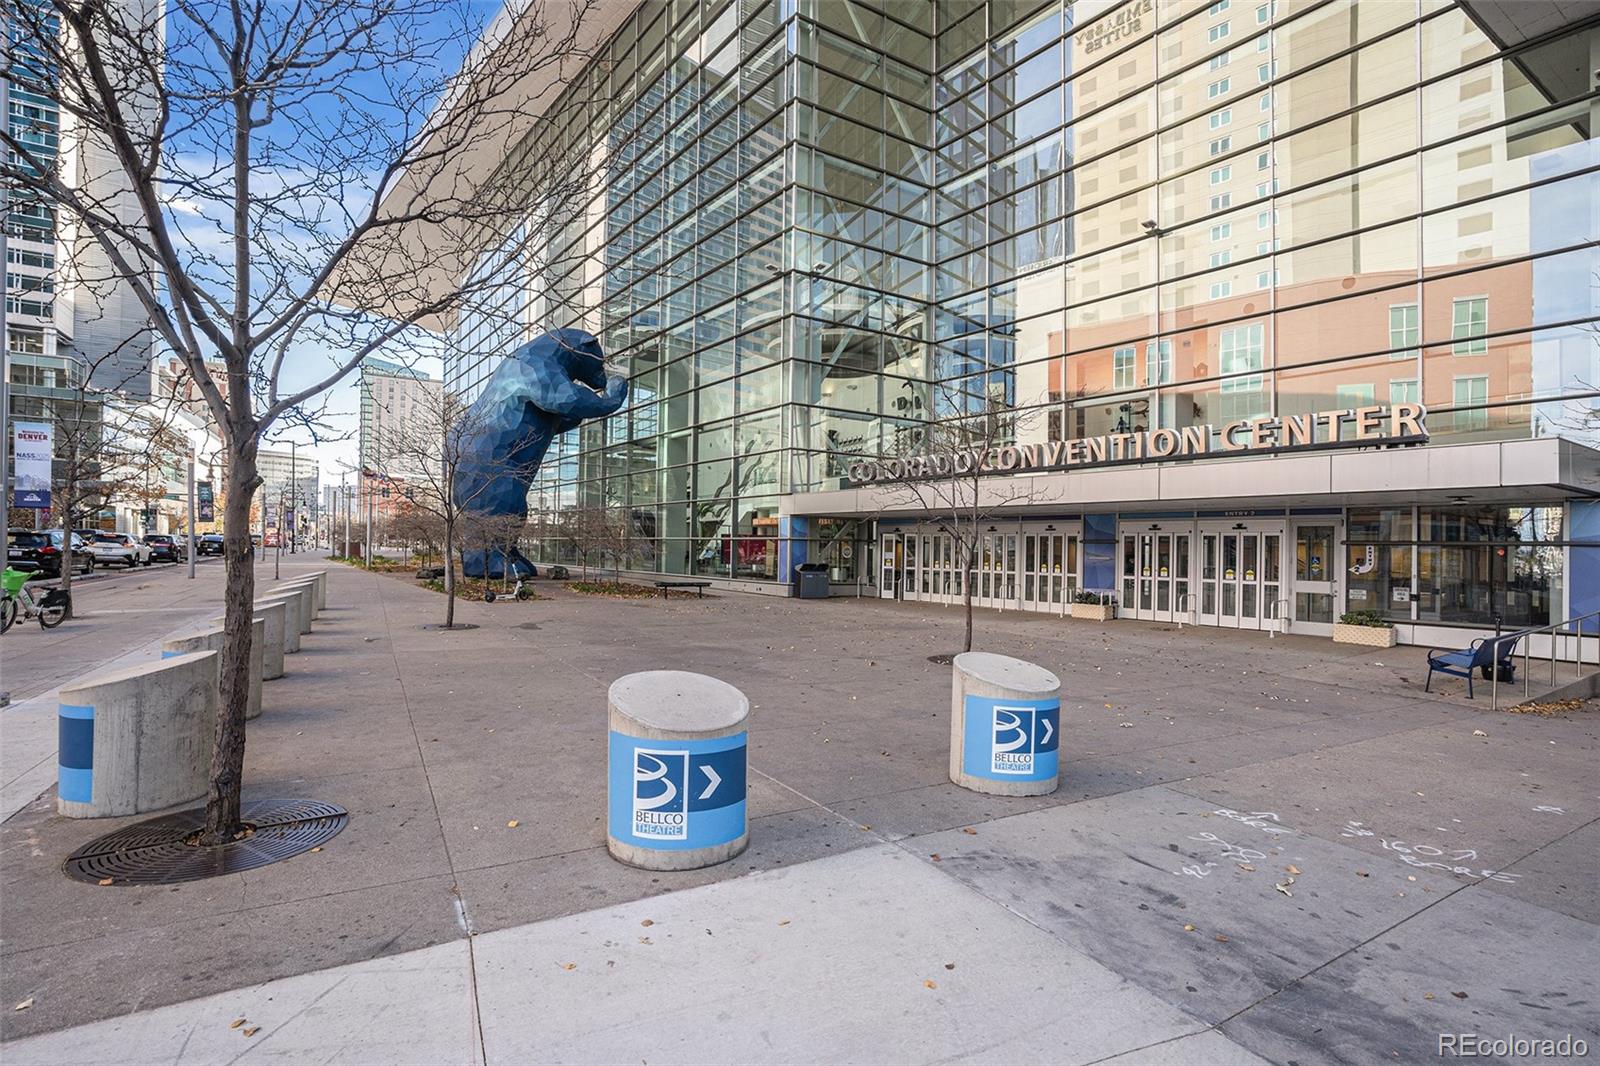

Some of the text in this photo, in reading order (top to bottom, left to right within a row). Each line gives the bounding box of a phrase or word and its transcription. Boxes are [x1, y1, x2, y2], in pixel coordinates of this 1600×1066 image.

[18, 432, 48, 441] DENVER
[847, 402, 1430, 483] COLORADO CONVENTION CENTER
[994, 752, 1032, 763] BELLCO
[994, 762, 1031, 772] THEATRE
[635, 810, 684, 825] BELLCO
[636, 823, 683, 836] THEATRE
